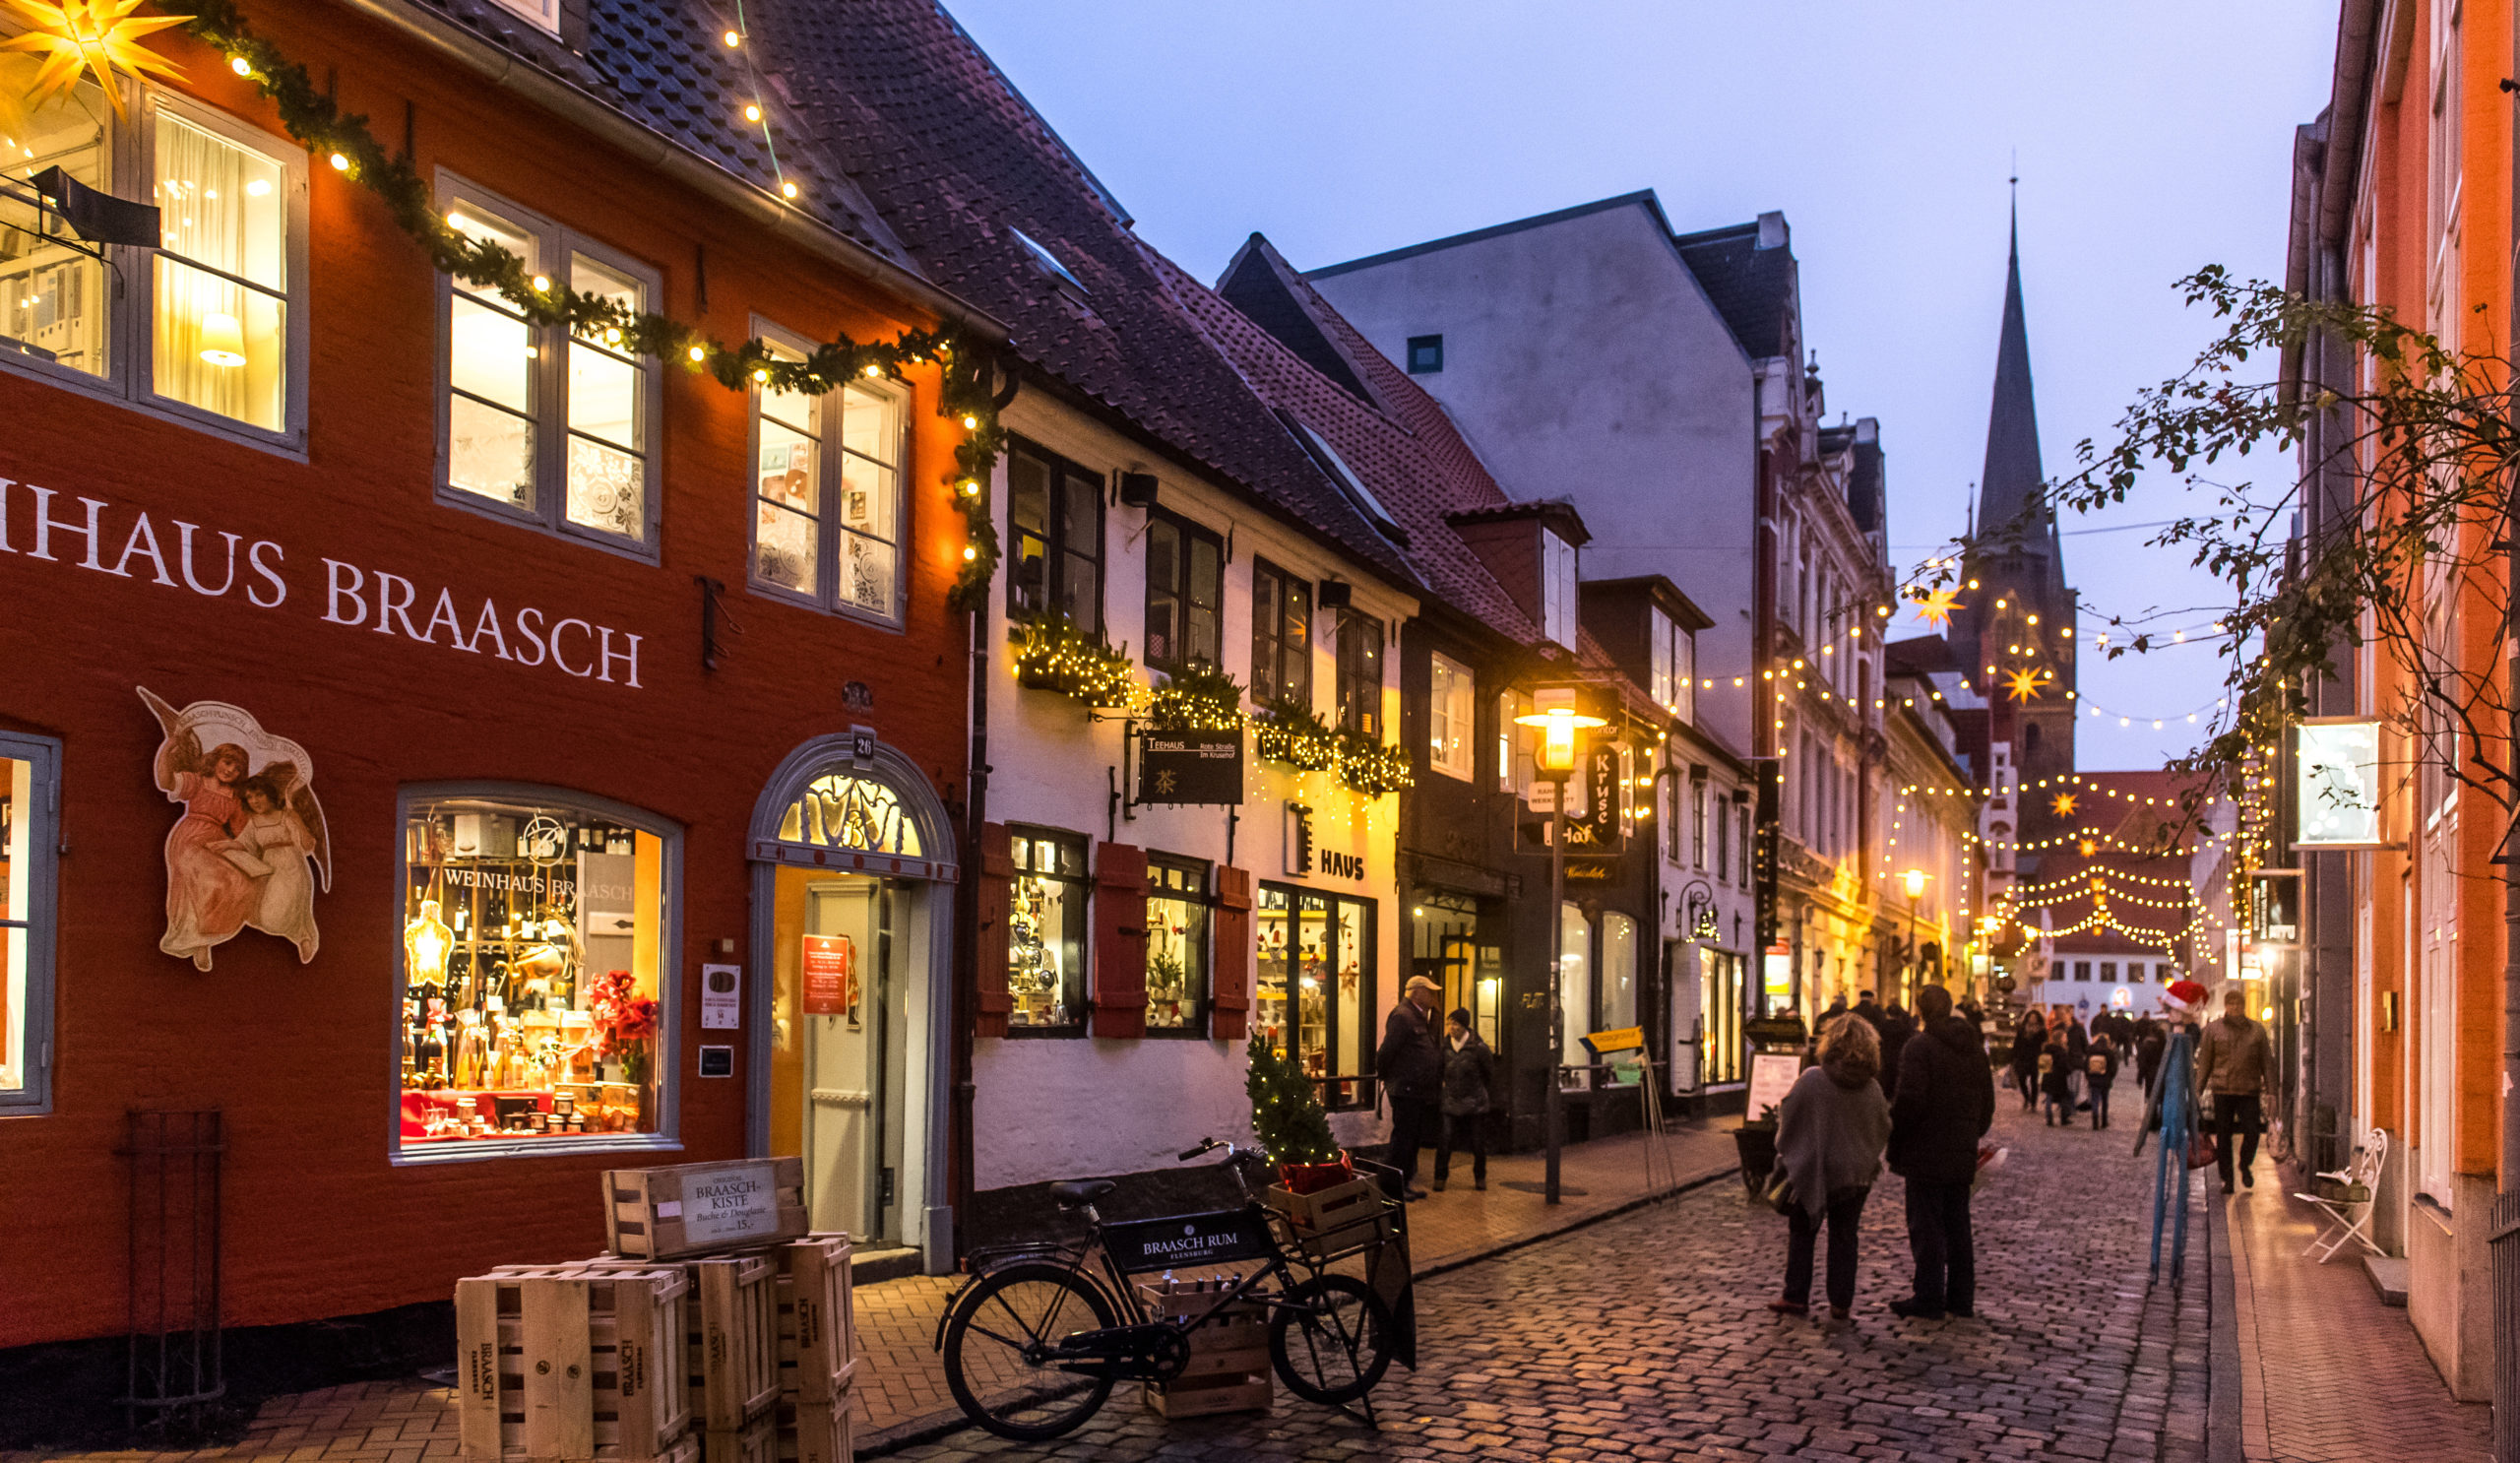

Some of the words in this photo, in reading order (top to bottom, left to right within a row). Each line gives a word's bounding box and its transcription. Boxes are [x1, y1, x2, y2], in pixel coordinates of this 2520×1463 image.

[320, 557, 644, 689] BRAASCH
[856, 737, 872, 755] 26
[1595, 754, 1610, 825] Kruse
[1320, 848, 1364, 881] HAUS
[444, 868, 545, 894] WEINHAUS
[711, 1193, 750, 1210] KISTE
[695, 1212, 721, 1223] Buche
[1143, 1236, 1204, 1255] BRAASCH
[1207, 1232, 1237, 1247] RUM
[1169, 1249, 1214, 1259] FLENSBURG
[480, 1342, 494, 1400] BRAASCH
[621, 1339, 635, 1398] BRAASCH
